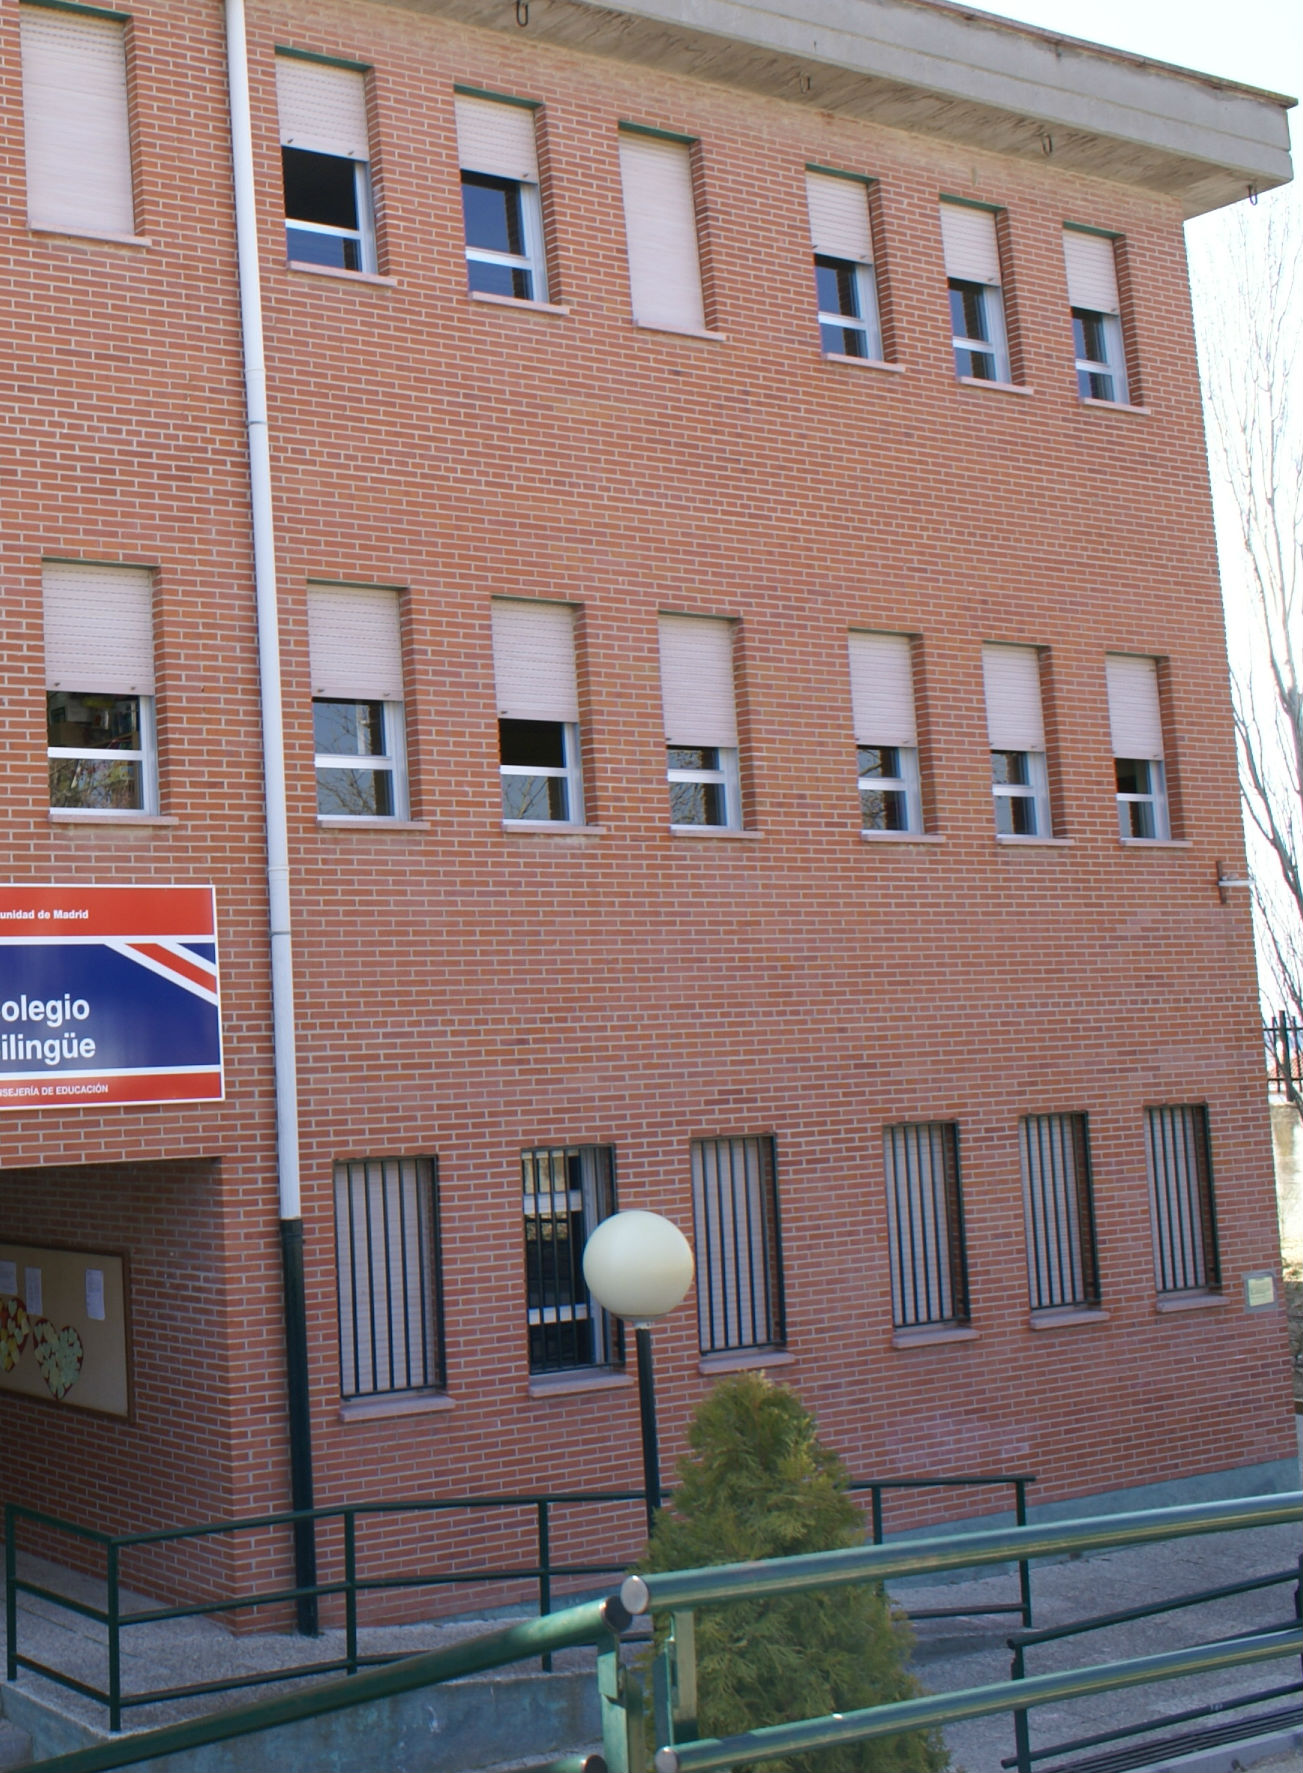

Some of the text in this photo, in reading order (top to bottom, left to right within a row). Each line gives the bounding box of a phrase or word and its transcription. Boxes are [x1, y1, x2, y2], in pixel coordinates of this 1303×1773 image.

[37, 909, 50, 920] de
[53, 909, 89, 920] Madrid
[41, 1087, 54, 1096] DE
[56, 1082, 109, 1095] EDUCACIÓN
